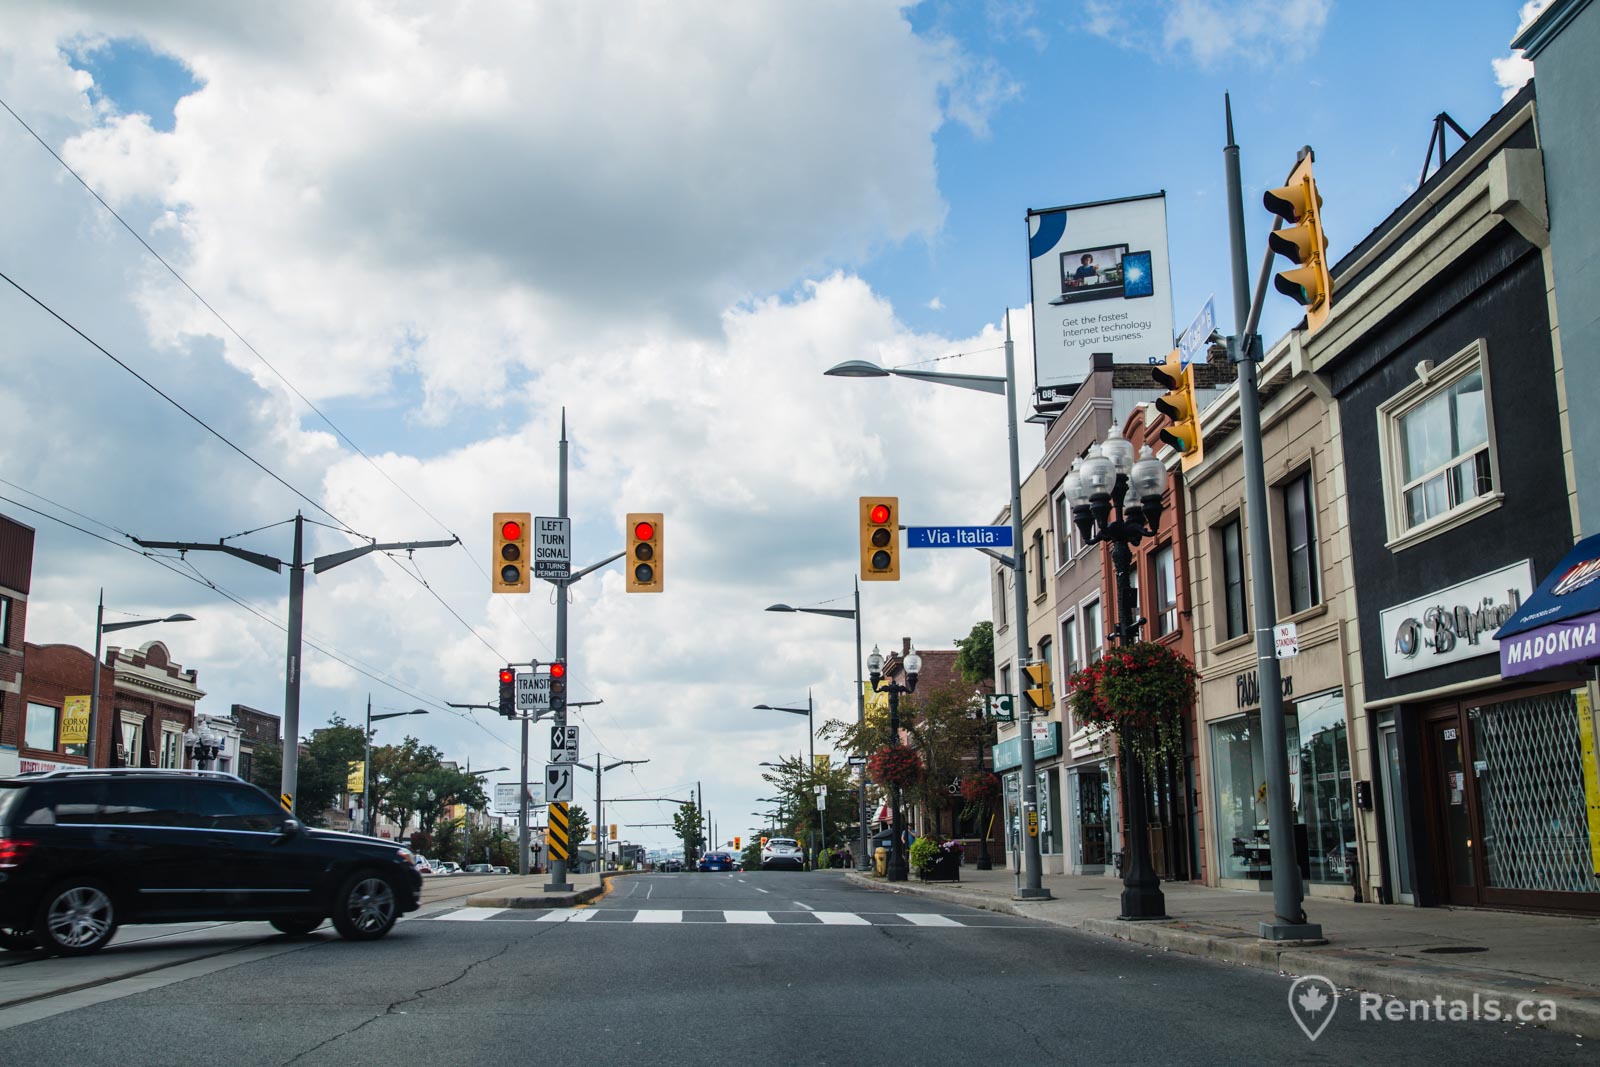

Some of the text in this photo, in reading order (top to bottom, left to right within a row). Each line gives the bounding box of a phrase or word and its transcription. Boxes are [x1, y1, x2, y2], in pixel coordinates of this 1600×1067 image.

[1062, 312, 1128, 327] Get the fastest
[1063, 321, 1152, 337] Internet technology
[1064, 332, 1144, 348] for your business.
[1042, 389, 1056, 399] 086
[541, 520, 564, 531] LEFT
[541, 534, 564, 544] TURN
[926, 528, 994, 544] Via Italia
[536, 548, 568, 558] SIGNAL
[1281, 628, 1288, 636] NO
[1276, 637, 1296, 648] STANDING
[1507, 622, 1596, 665] MADONNA
[520, 678, 550, 690] TRANSIT
[521, 693, 548, 704] SIGNAL
[63, 718, 88, 726] CORSO
[62, 725, 87, 733] ITALIA
